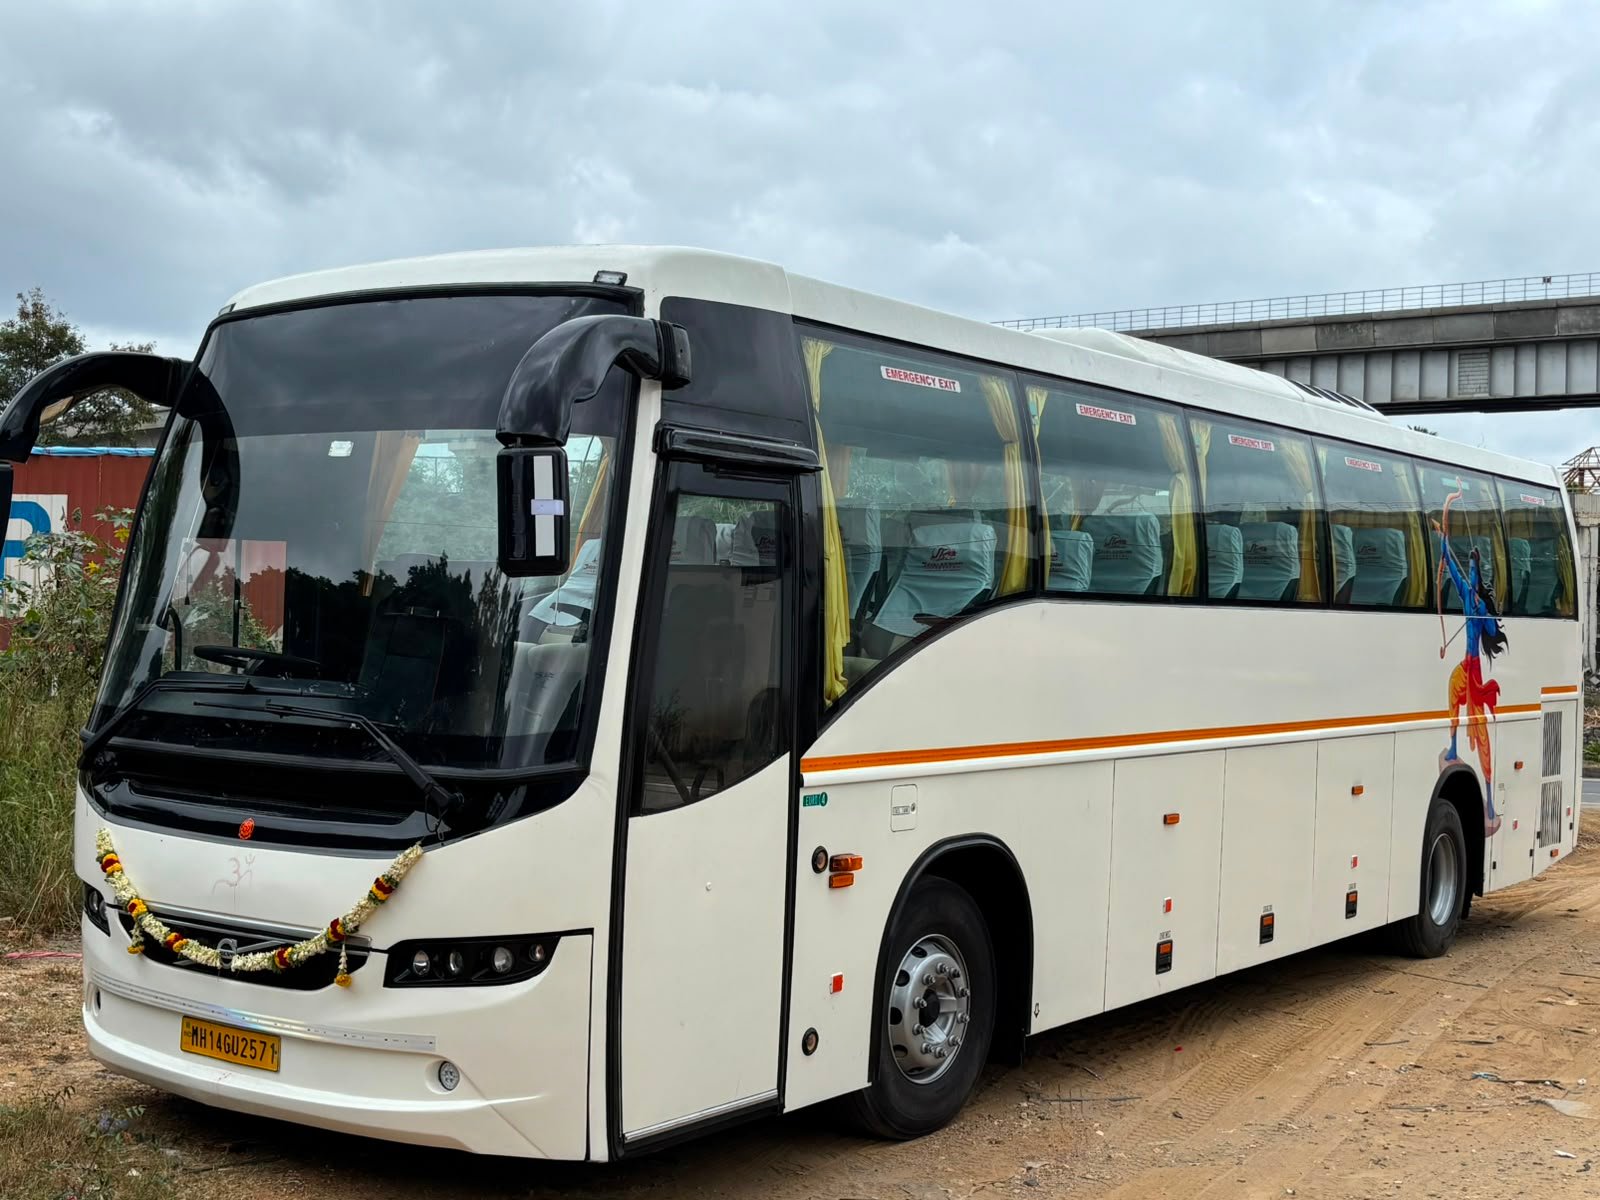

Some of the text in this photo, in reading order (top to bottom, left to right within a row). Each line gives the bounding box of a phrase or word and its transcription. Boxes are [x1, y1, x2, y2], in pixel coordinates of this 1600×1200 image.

[885, 367, 956, 391] EMERGENCY EXIT
[1080, 405, 1133, 424] EMERGENCY EXIT
[191, 1025, 275, 1065] MH14GU2571
